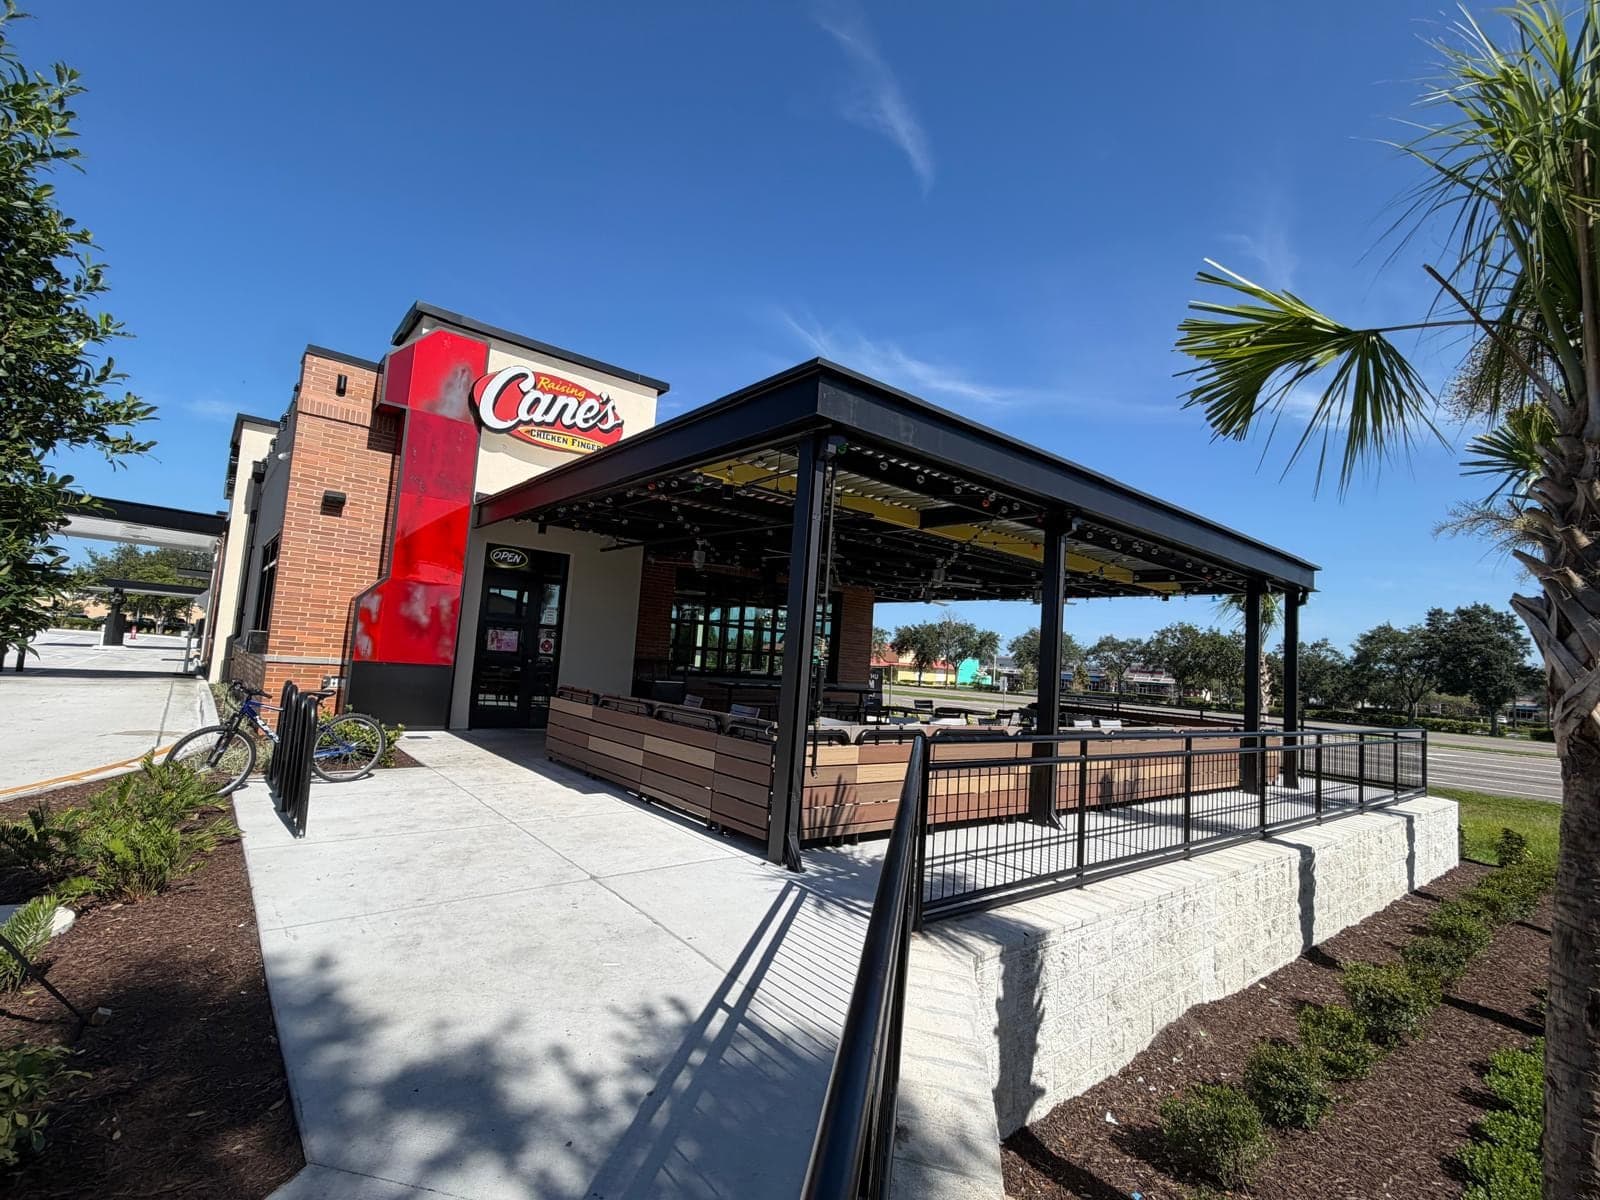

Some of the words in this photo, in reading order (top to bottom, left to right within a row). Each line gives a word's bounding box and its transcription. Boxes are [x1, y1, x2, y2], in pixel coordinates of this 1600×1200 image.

[479, 365, 624, 431] Cane's
[536, 376, 586, 401] Raising
[530, 428, 568, 445] CHICKEN
[571, 439, 603, 452] FINGER
[492, 551, 522, 564] OPEN
